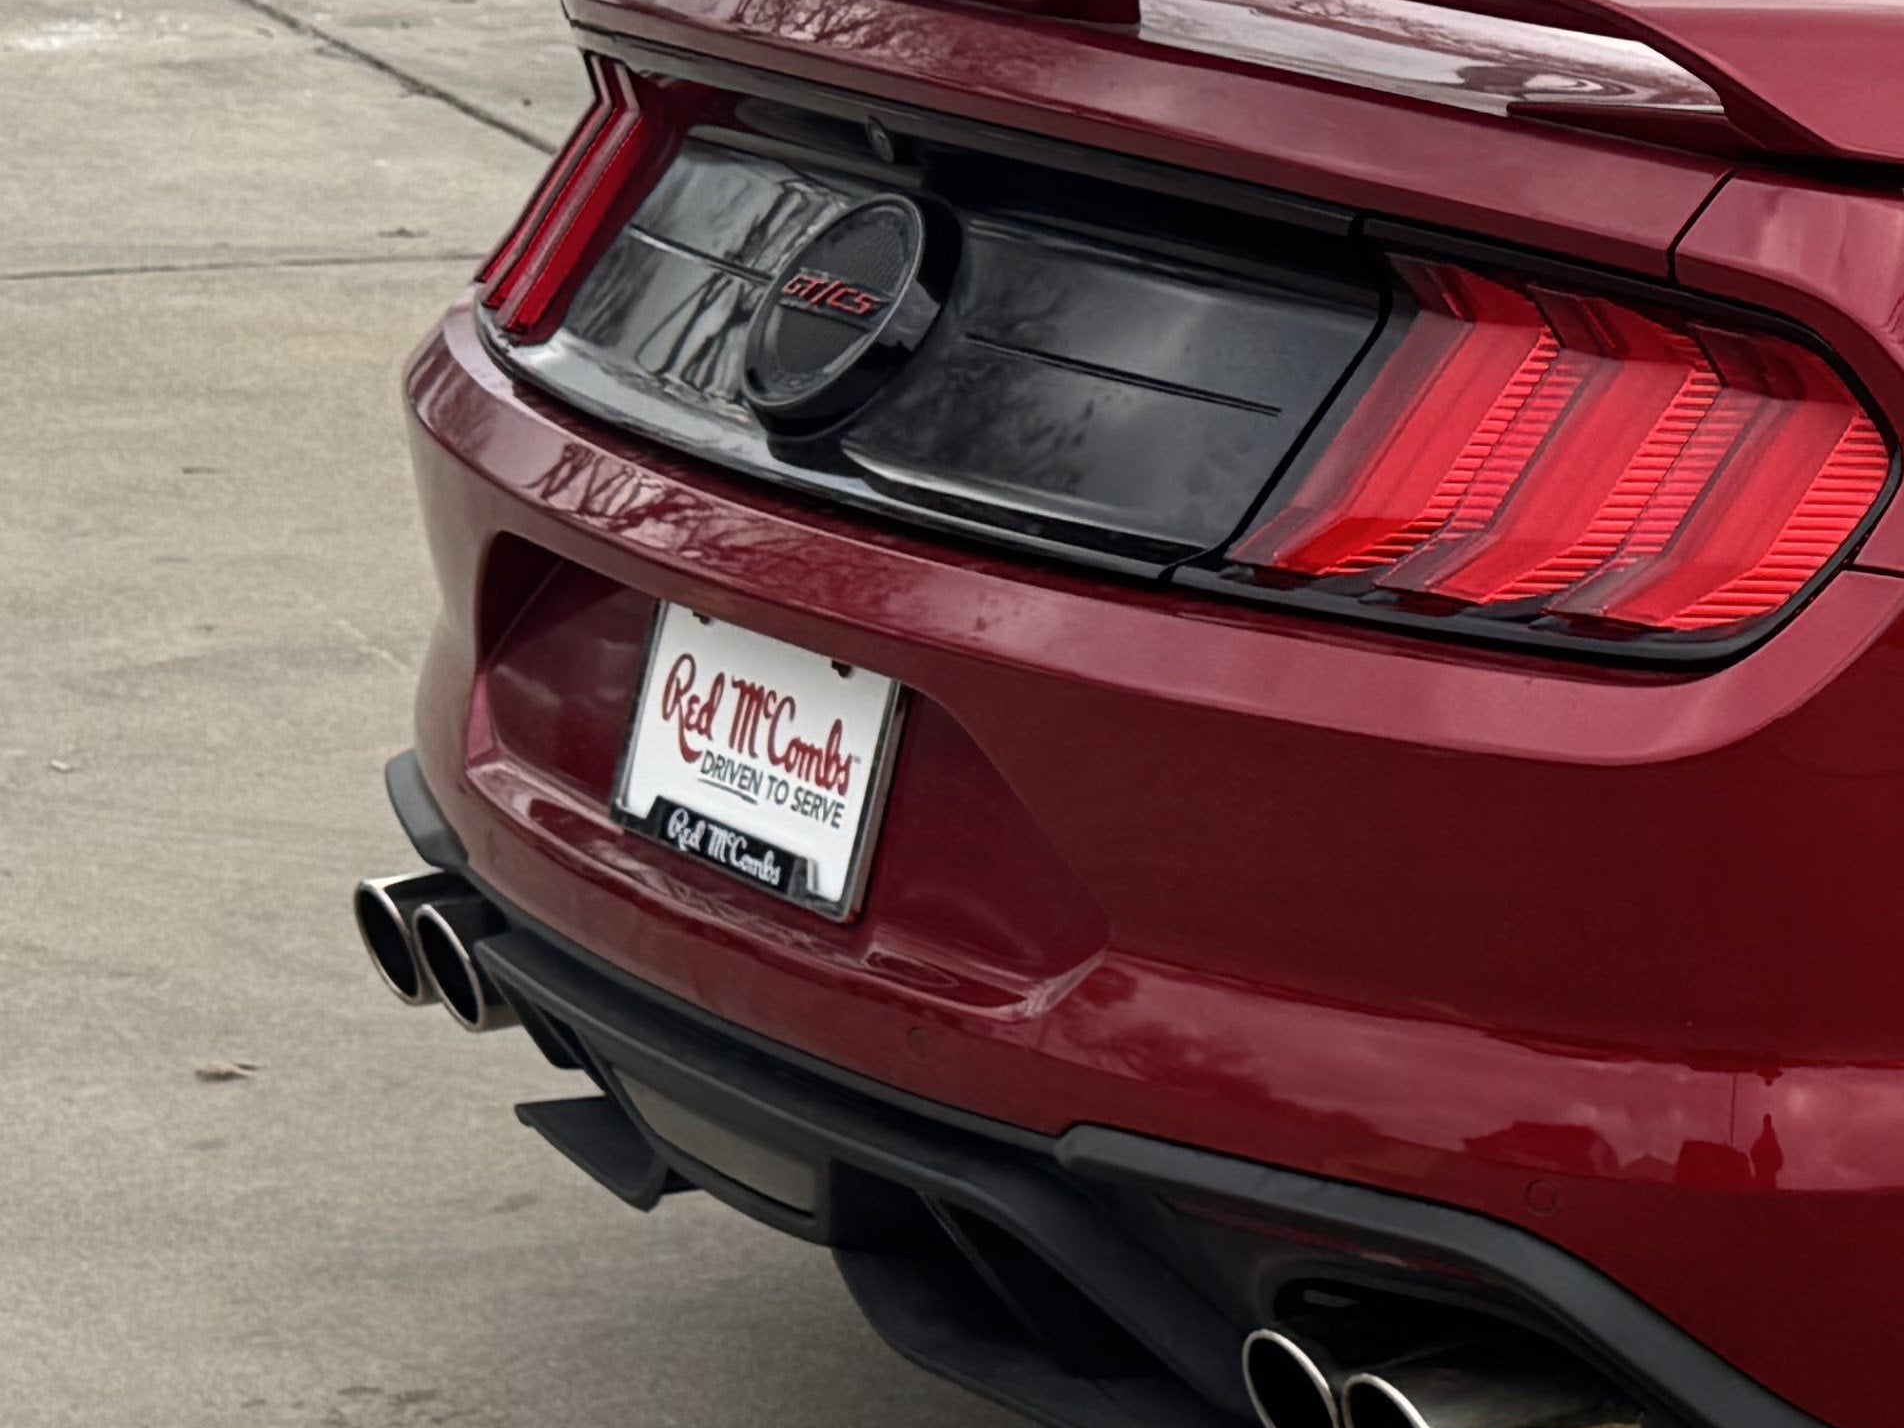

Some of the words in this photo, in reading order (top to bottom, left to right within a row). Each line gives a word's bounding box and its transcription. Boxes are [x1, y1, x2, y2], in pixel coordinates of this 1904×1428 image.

[781, 274, 889, 317] GT/CS
[661, 652, 726, 765] Red
[729, 678, 854, 797] McCombs
[700, 749, 763, 793] DRIVEN
[766, 774, 790, 808] TO
[791, 786, 845, 830] SERVE
[668, 807, 702, 852] Red
[706, 821, 783, 886] McCombs
